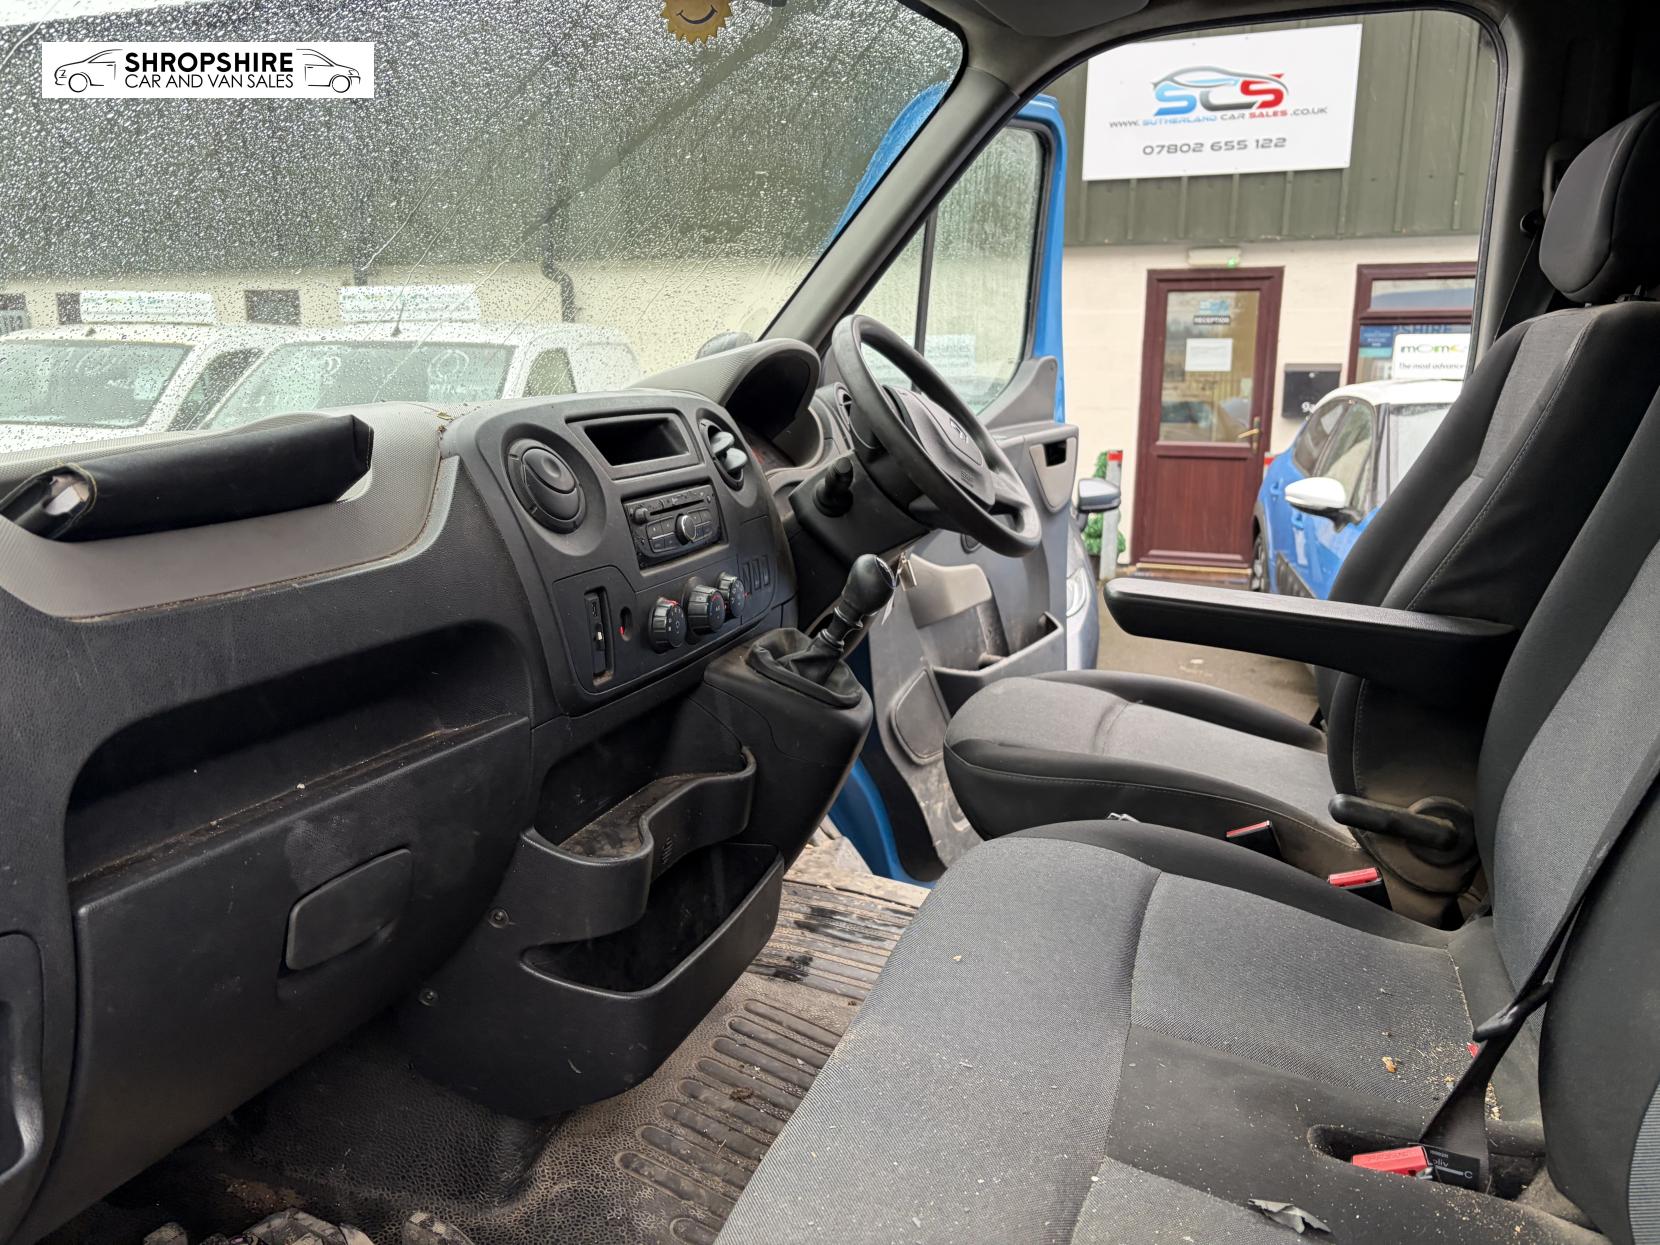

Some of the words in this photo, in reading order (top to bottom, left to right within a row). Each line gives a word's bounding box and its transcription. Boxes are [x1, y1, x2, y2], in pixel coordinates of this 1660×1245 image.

[1220, 112, 1246, 121] CAR
[1248, 108, 1288, 119] SALES
[1142, 141, 1205, 156] 07802
[1210, 138, 1249, 152] 655
[1255, 136, 1287, 150] 122
